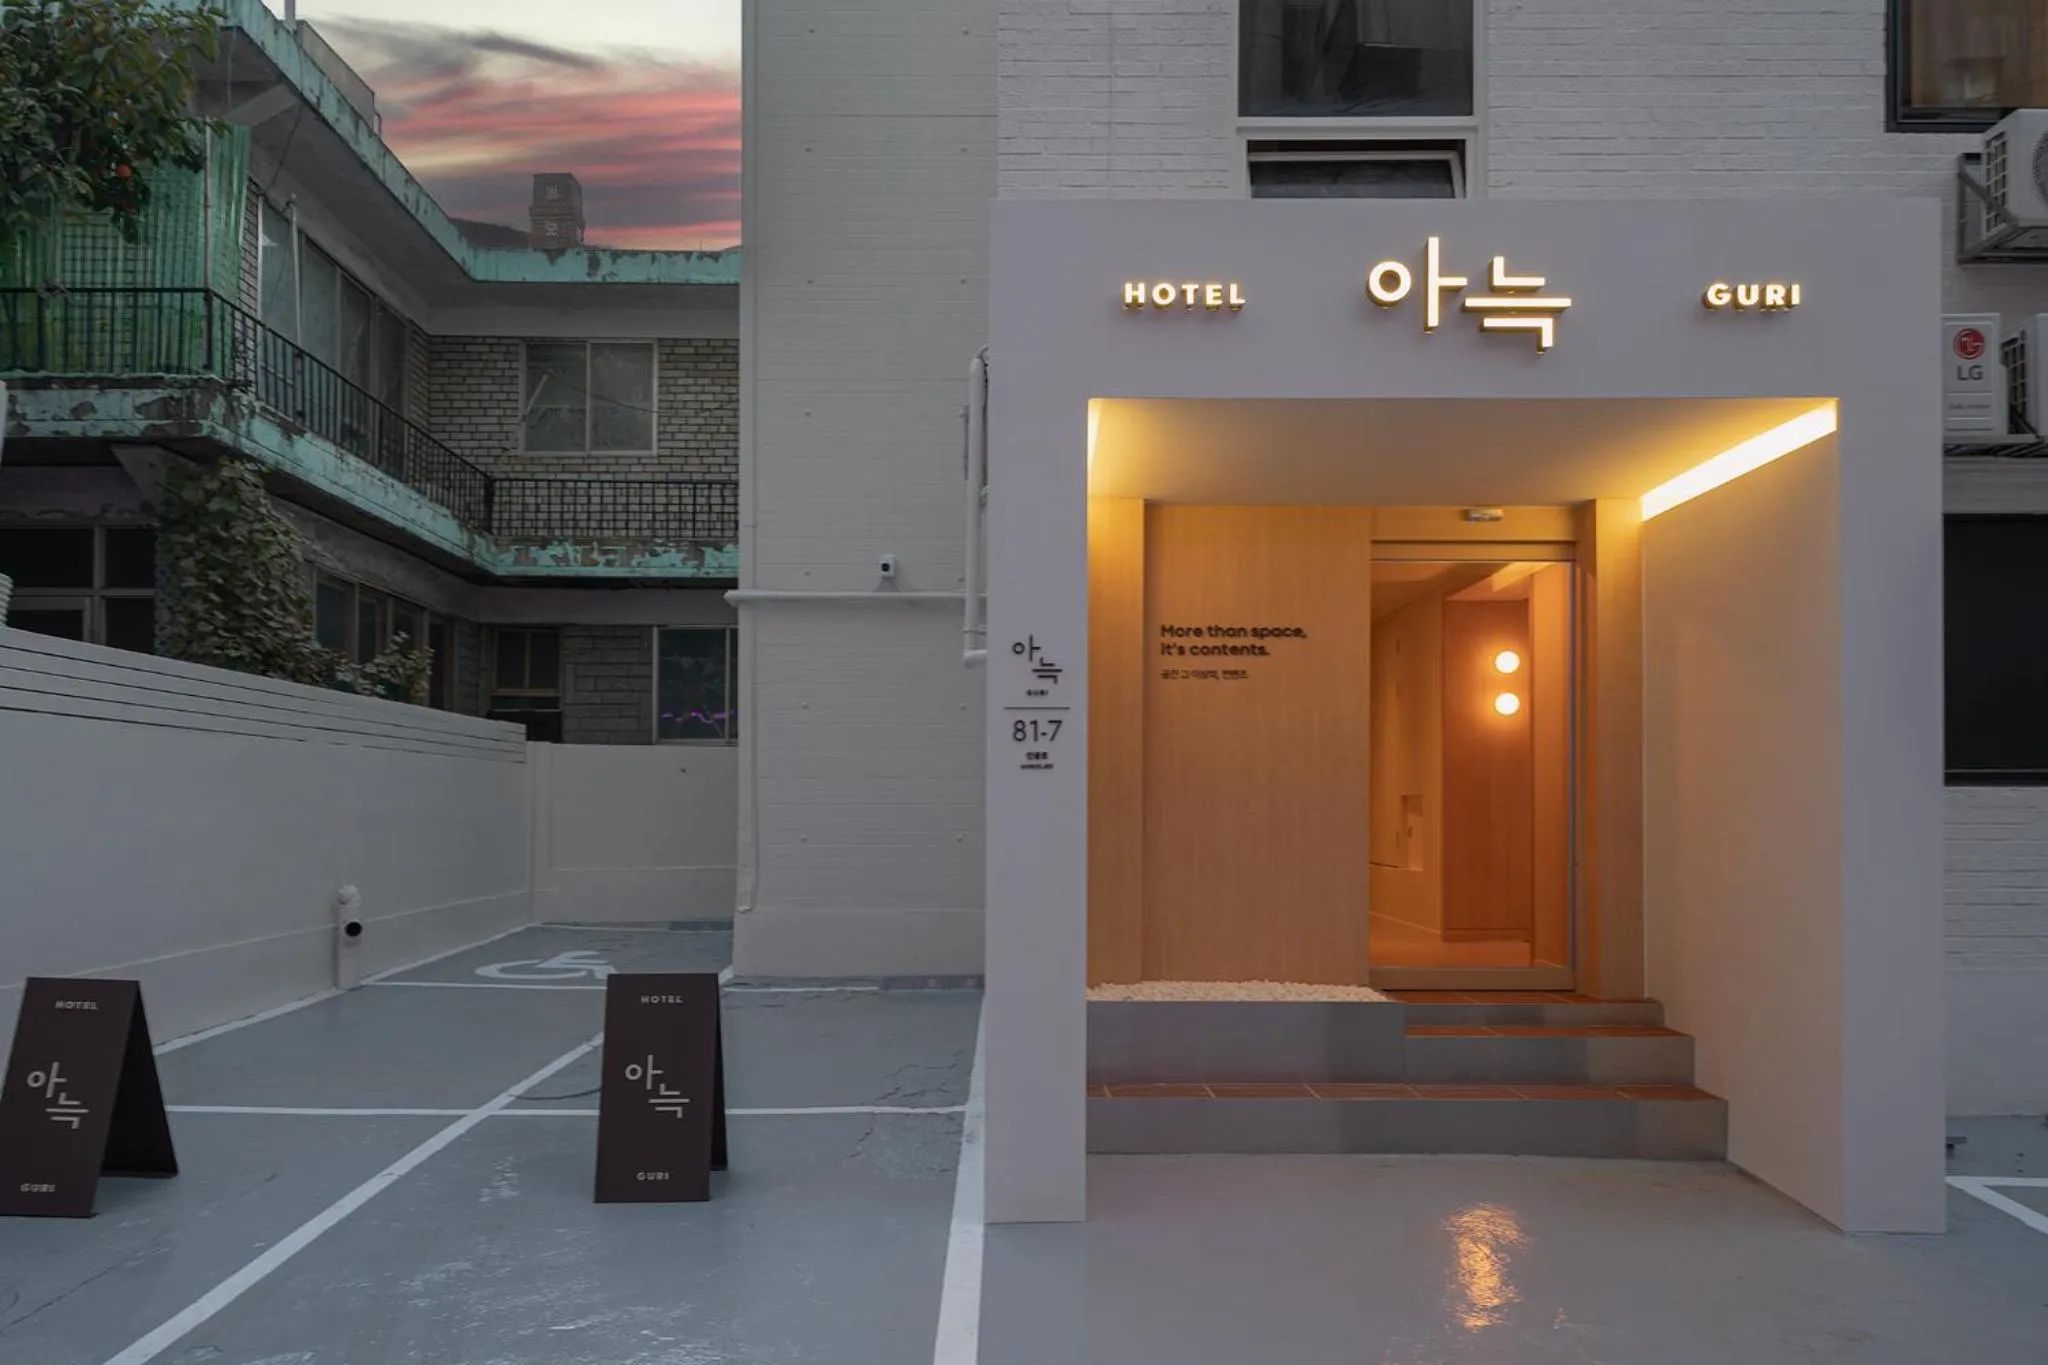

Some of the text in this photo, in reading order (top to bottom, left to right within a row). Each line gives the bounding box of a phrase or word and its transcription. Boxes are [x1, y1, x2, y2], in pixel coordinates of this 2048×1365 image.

[1124, 236, 1802, 350] HOTEL 아늑 GURI
[1957, 364, 1985, 382] LG
[1161, 625, 1204, 638] More
[1207, 624, 1247, 638] than
[1011, 634, 1063, 685] 아늑
[1012, 719, 1063, 743] 81-7
[54, 1000, 99, 1011] HOTEL
[640, 995, 684, 1005] HOTEL
[26, 1061, 90, 1130] 아늑
[624, 1054, 691, 1119] 아늑
[636, 1171, 670, 1181] GURI
